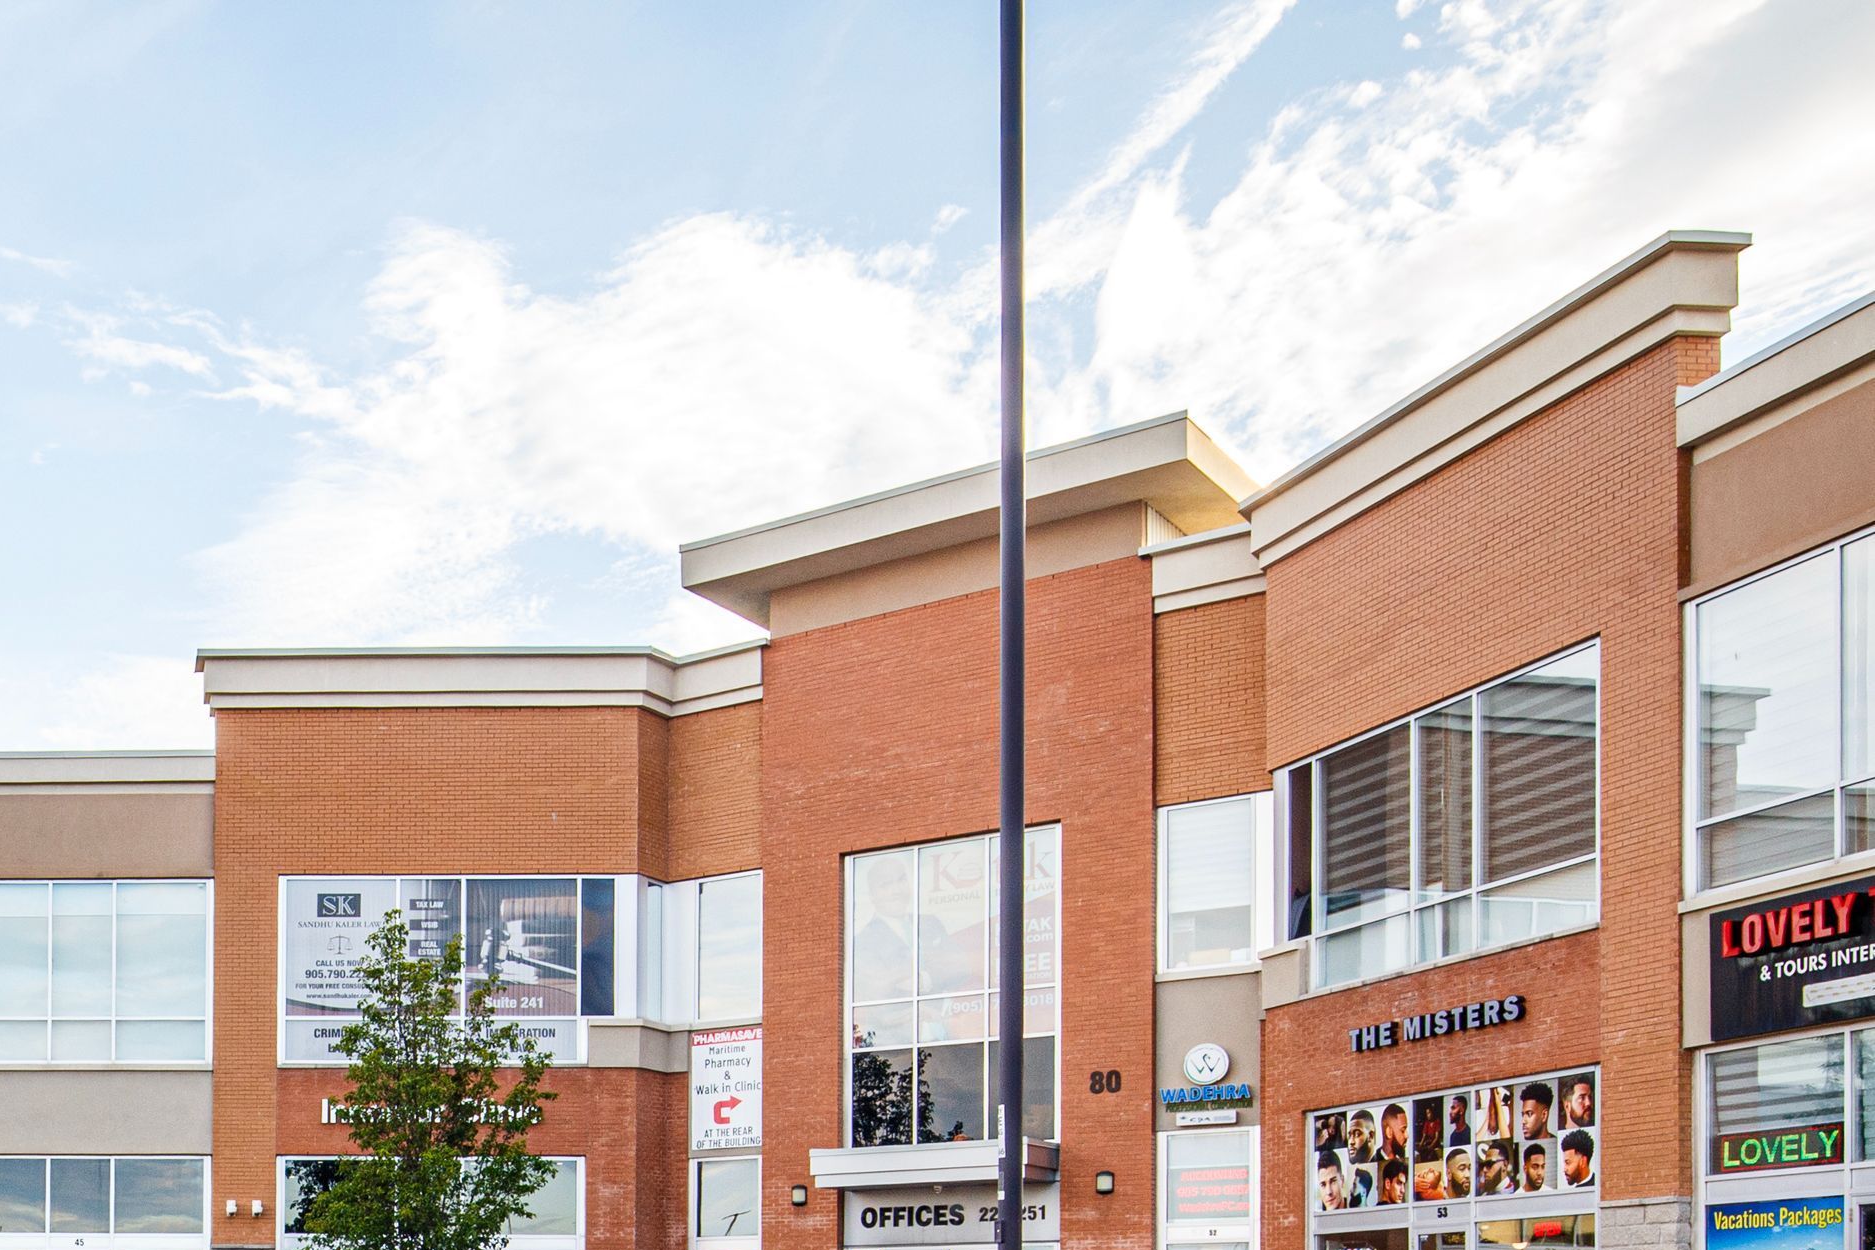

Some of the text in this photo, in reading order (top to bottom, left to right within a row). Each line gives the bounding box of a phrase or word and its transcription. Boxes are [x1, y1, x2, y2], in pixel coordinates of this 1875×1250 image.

[322, 895, 356, 915] SK
[297, 920, 382, 928] SANDHU KALER LAW
[1721, 892, 1858, 958] LOVELY
[420, 940, 438, 948] REAL
[417, 948, 441, 956] ESTATE
[305, 969, 369, 979] 905.790.22
[1759, 965, 1771, 982] &
[1775, 954, 1827, 978] TOURS
[484, 996, 544, 1009] Suite 241
[1348, 995, 1523, 1052] THE MISTERS
[693, 1028, 762, 1044] PHARMASAVE
[708, 1045, 746, 1055] Maritime
[704, 1057, 752, 1069] Pharmacy
[723, 1070, 731, 1080] &
[695, 1080, 762, 1095] Walk in Clinic
[1089, 1070, 1122, 1095] 80
[1159, 1083, 1251, 1104] WADEHRA
[704, 1126, 753, 1138] AT THE REAR
[696, 1136, 761, 1149] OF THE BUILDING
[1723, 1130, 1839, 1167] LOVELY
[861, 1204, 965, 1229] OFFICES
[1437, 1207, 1448, 1218] 53
[1713, 1206, 1843, 1231] Vacations Packages
[74, 1238, 85, 1246] 45
